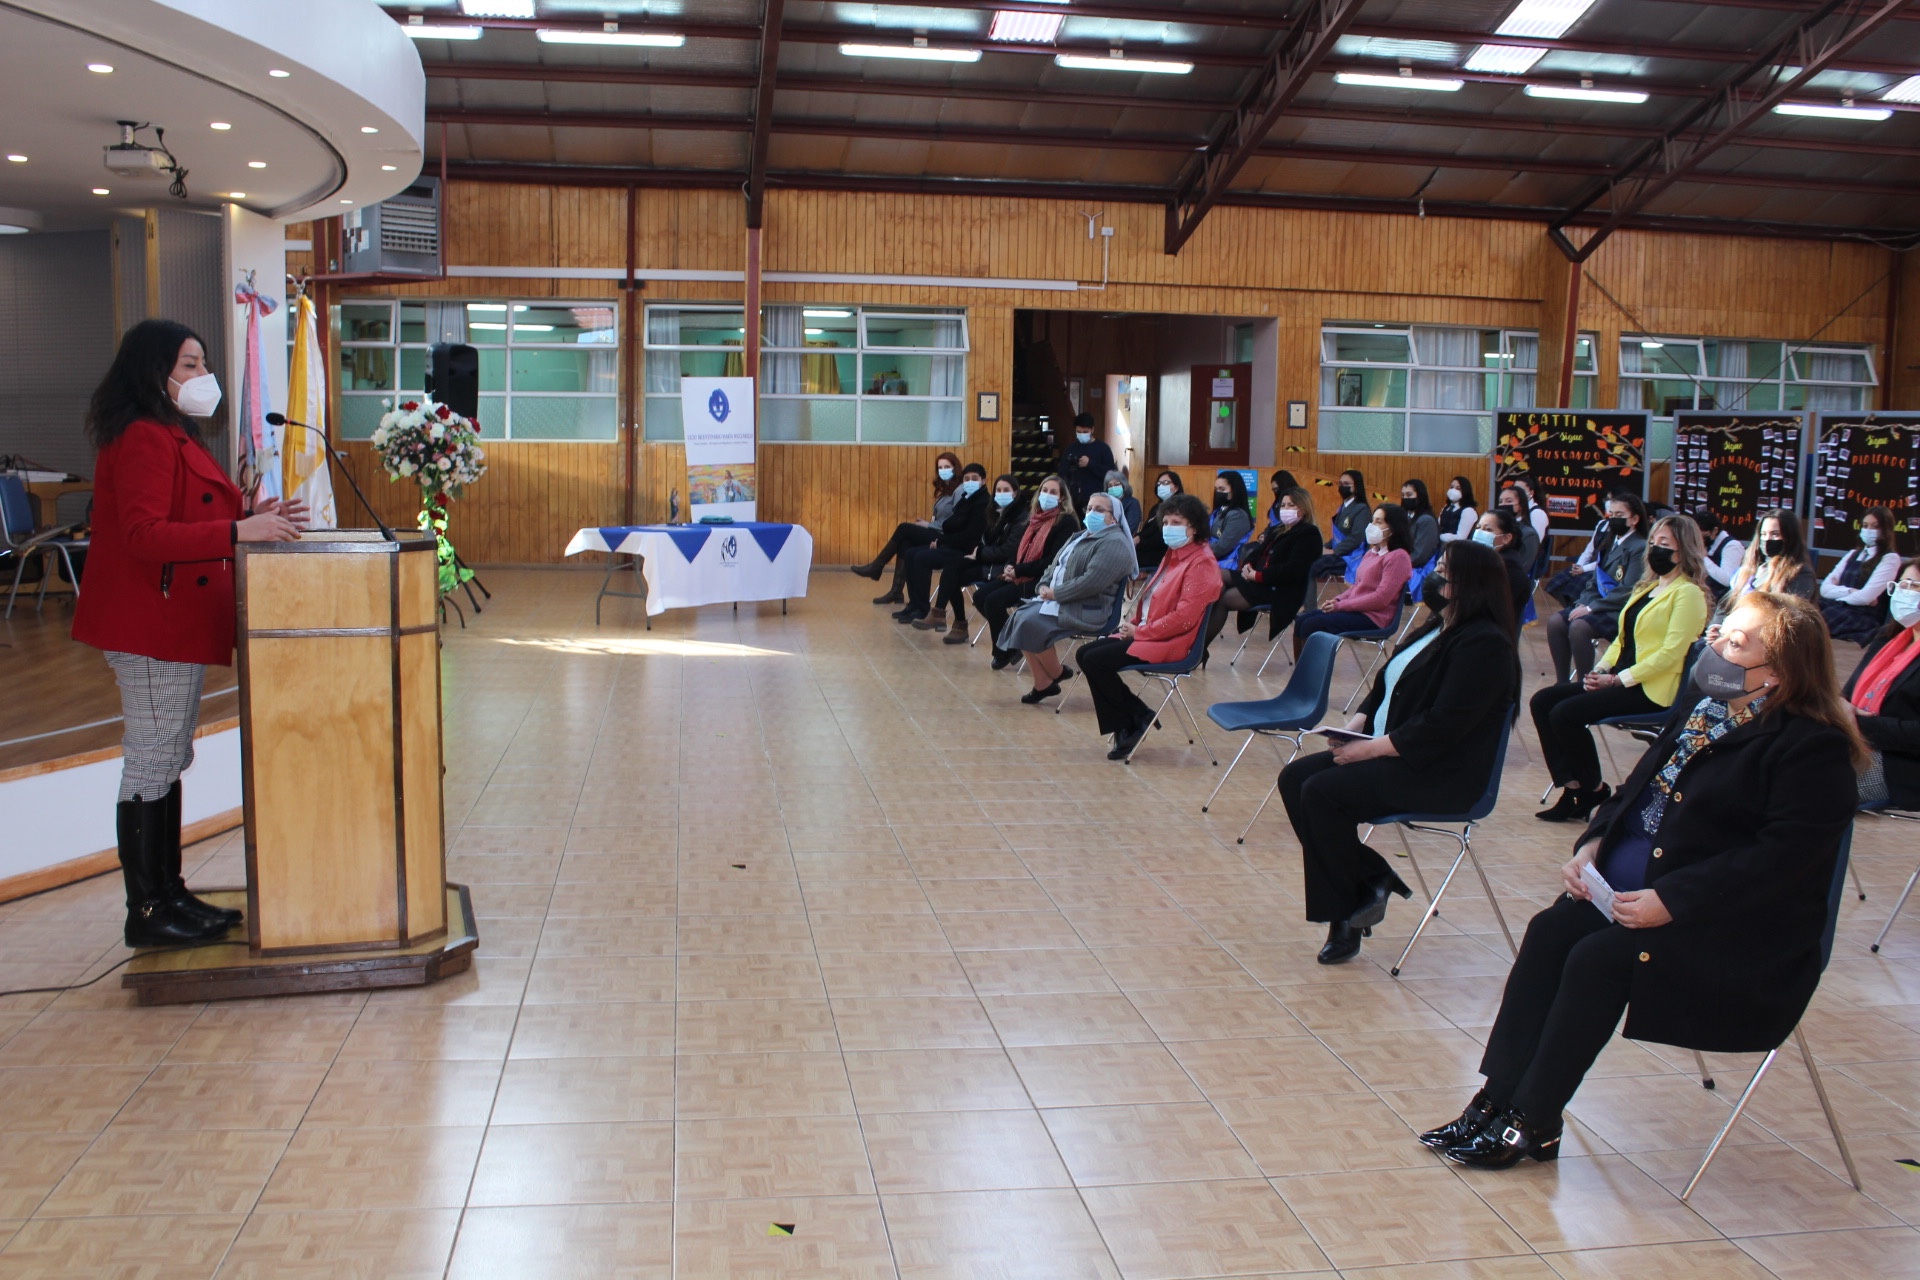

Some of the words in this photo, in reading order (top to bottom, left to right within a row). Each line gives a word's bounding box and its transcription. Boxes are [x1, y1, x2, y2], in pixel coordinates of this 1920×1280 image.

[1537, 449, 1601, 461] BUSCANDO
[1851, 454, 1907, 469] PIDIENDO
[1719, 483, 1743, 496] puerta
